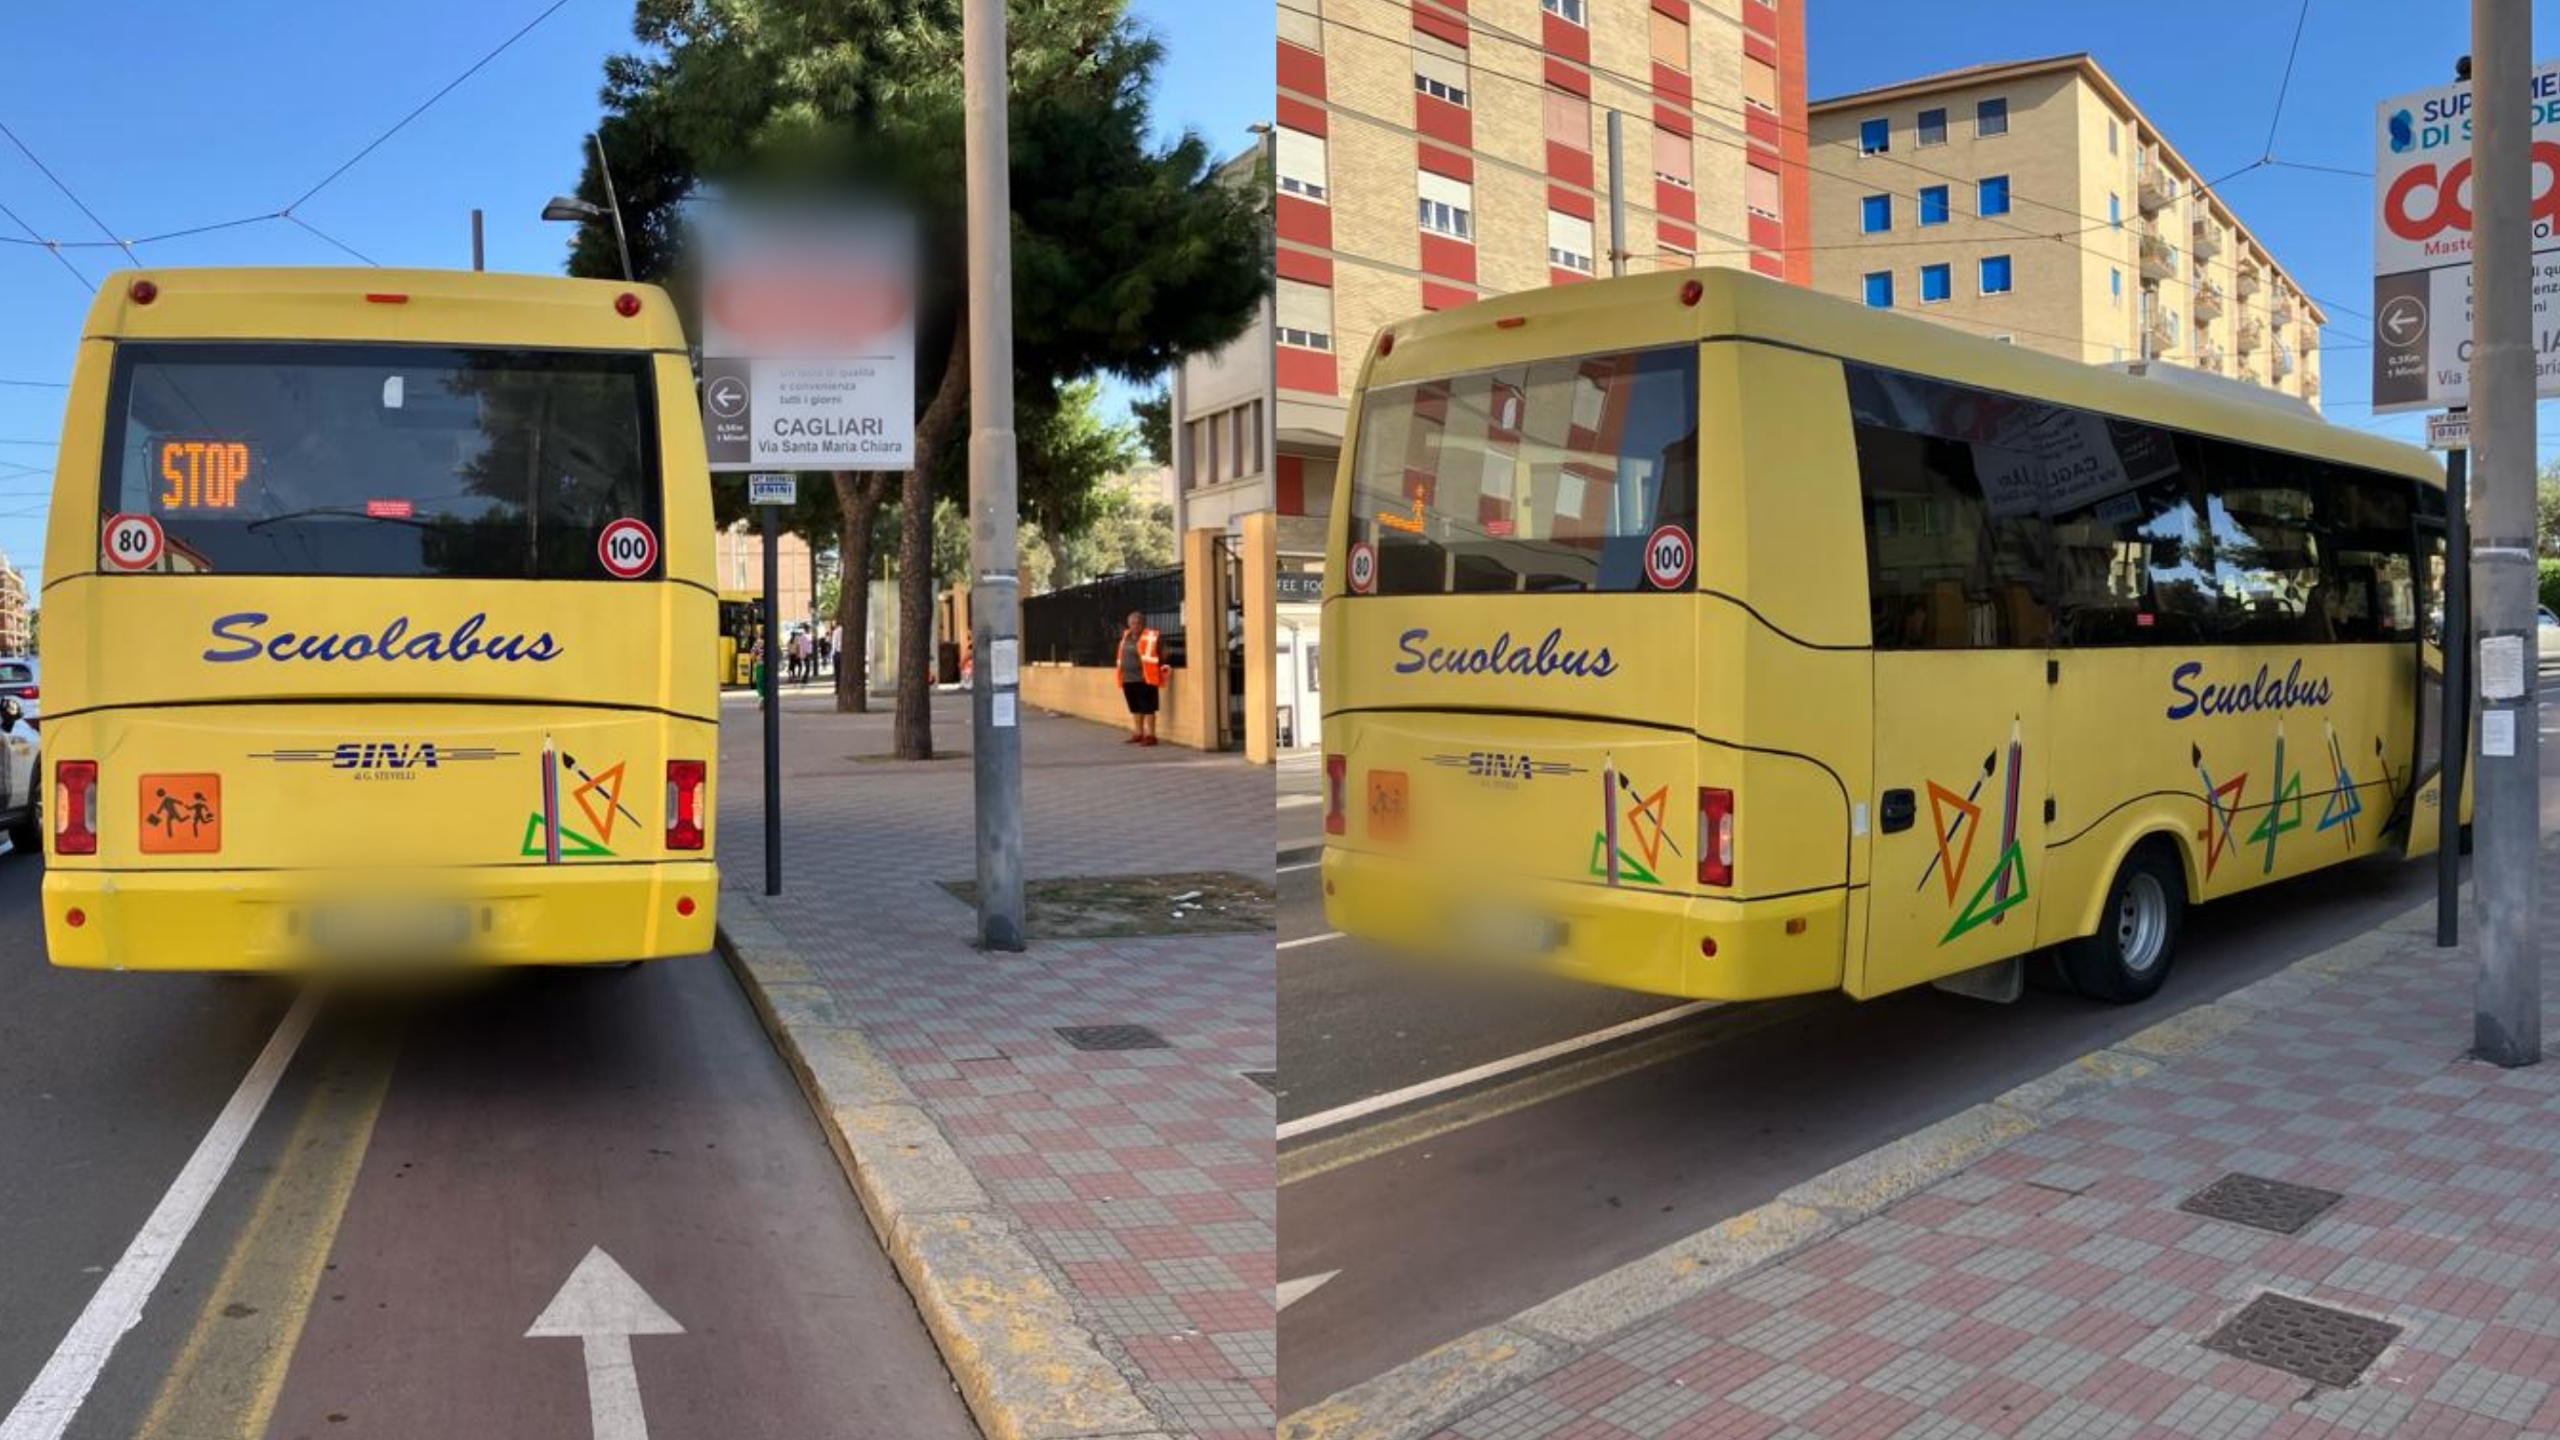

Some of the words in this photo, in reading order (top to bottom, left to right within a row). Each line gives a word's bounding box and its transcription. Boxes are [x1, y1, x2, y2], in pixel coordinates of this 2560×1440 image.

[2422, 124, 2450, 149] DI
[2437, 369, 2463, 385] Via
[773, 417, 883, 437] CAGLIARI
[758, 440, 778, 452] Via
[782, 440, 818, 453] Santa
[822, 440, 857, 453] Maria
[860, 439, 902, 453] Chiara
[162, 443, 248, 507] STOP
[118, 528, 148, 553] 80
[608, 535, 647, 562] 100
[1354, 555, 1370, 578] 80
[1652, 544, 1685, 571] 100
[203, 612, 563, 662] Scuolabus
[1394, 627, 1619, 677] Scuolabus
[2166, 658, 2332, 721] Scuolabus
[332, 743, 438, 768] SINA
[1468, 752, 1532, 779] SINA
